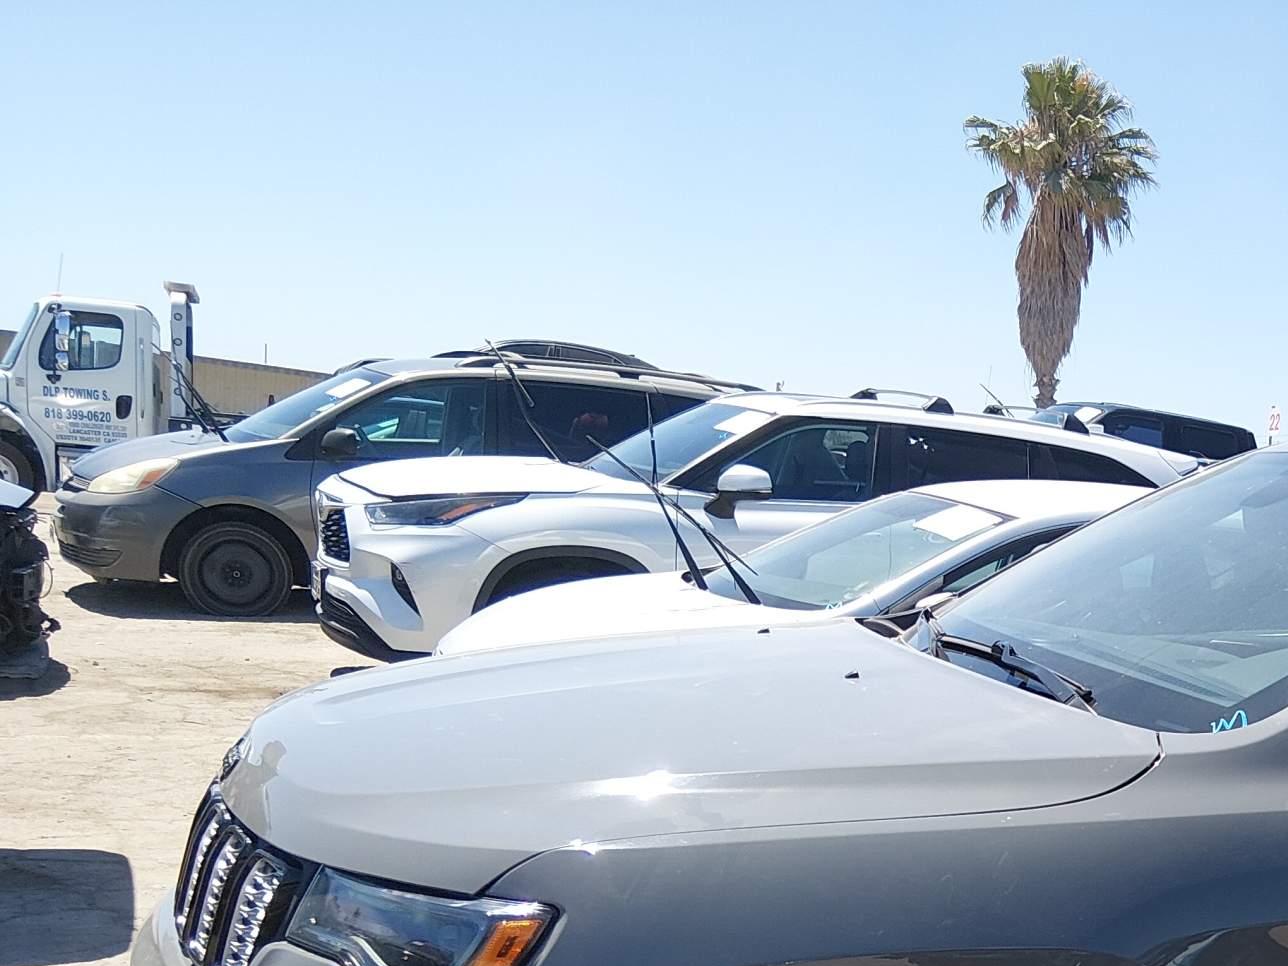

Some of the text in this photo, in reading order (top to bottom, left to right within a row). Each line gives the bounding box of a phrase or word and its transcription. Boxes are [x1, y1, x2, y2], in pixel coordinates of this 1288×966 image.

[43, 385, 60, 397] DLP
[63, 387, 100, 400] TOWING
[44, 407, 112, 423] 818 399-0620
[1269, 413, 1281, 431] 22
